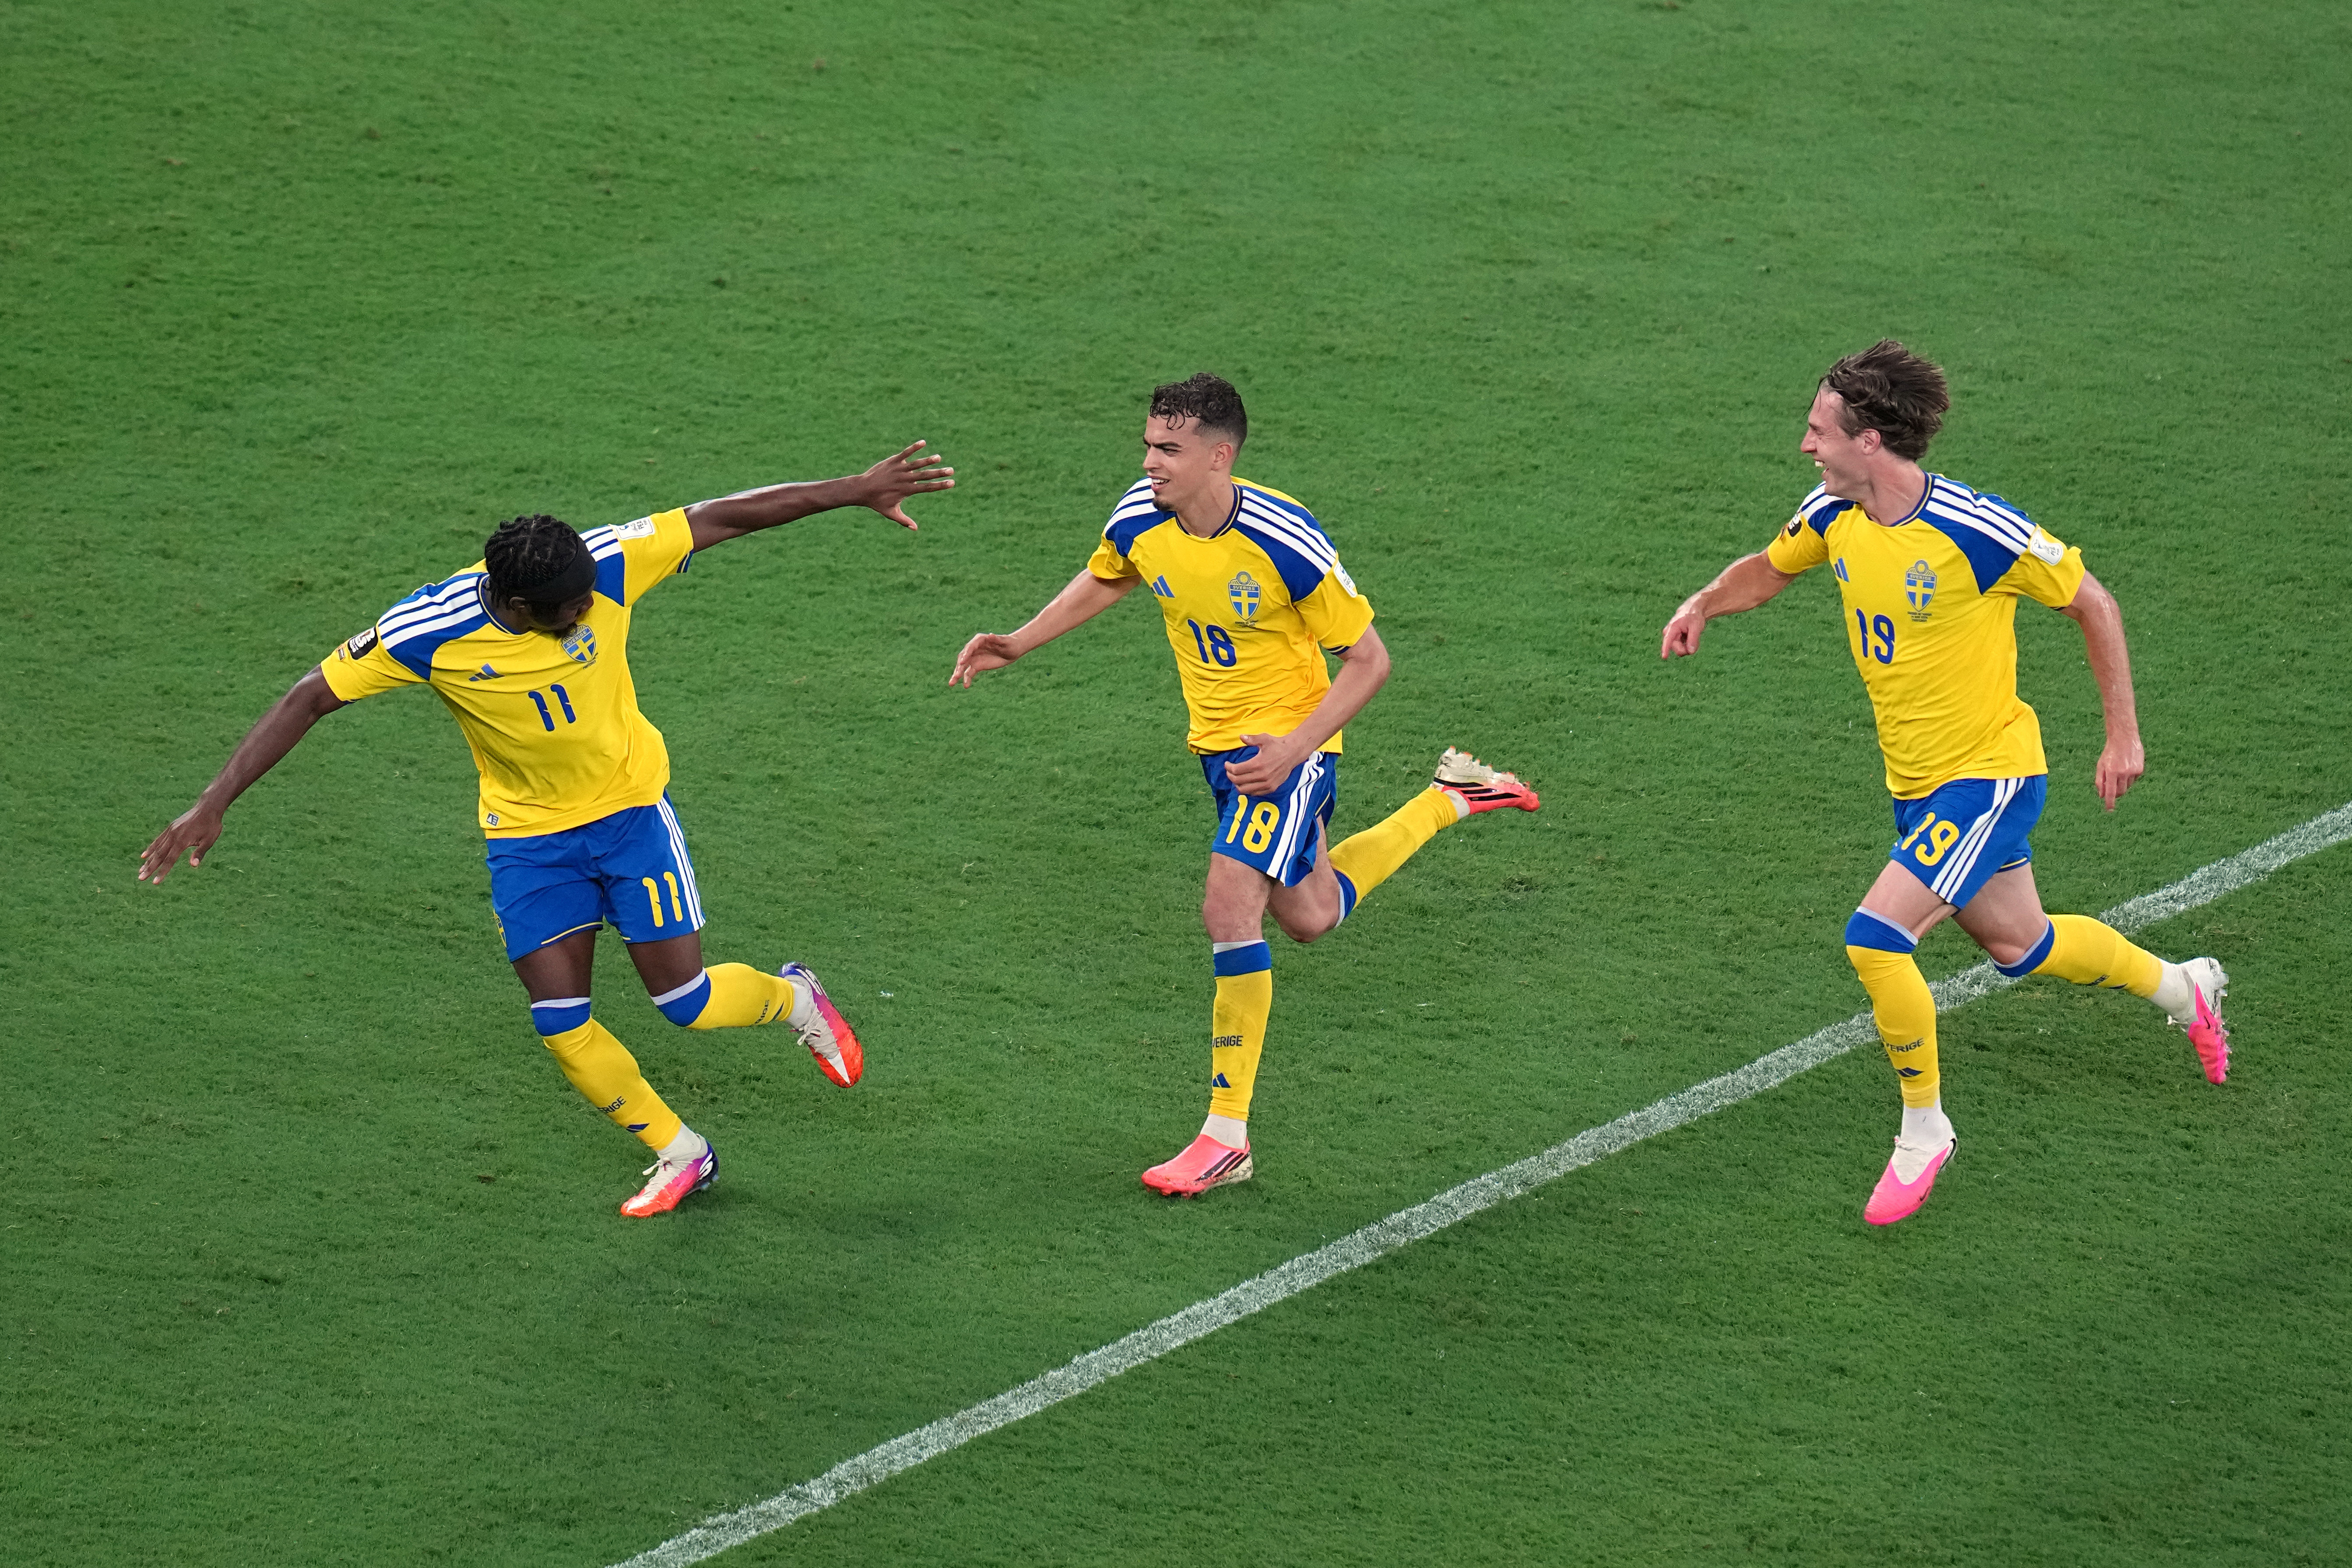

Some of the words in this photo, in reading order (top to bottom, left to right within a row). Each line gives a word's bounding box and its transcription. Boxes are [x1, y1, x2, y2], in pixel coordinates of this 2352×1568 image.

[566, 629, 587, 646] SVERIGE
[1188, 619, 1237, 667] 18
[1856, 608, 1895, 664] 19
[528, 684, 576, 731] 11
[1226, 795, 1280, 853] 18
[1901, 812, 1960, 866] 19
[642, 871, 683, 927] 11
[750, 1000, 769, 1025] RIGE
